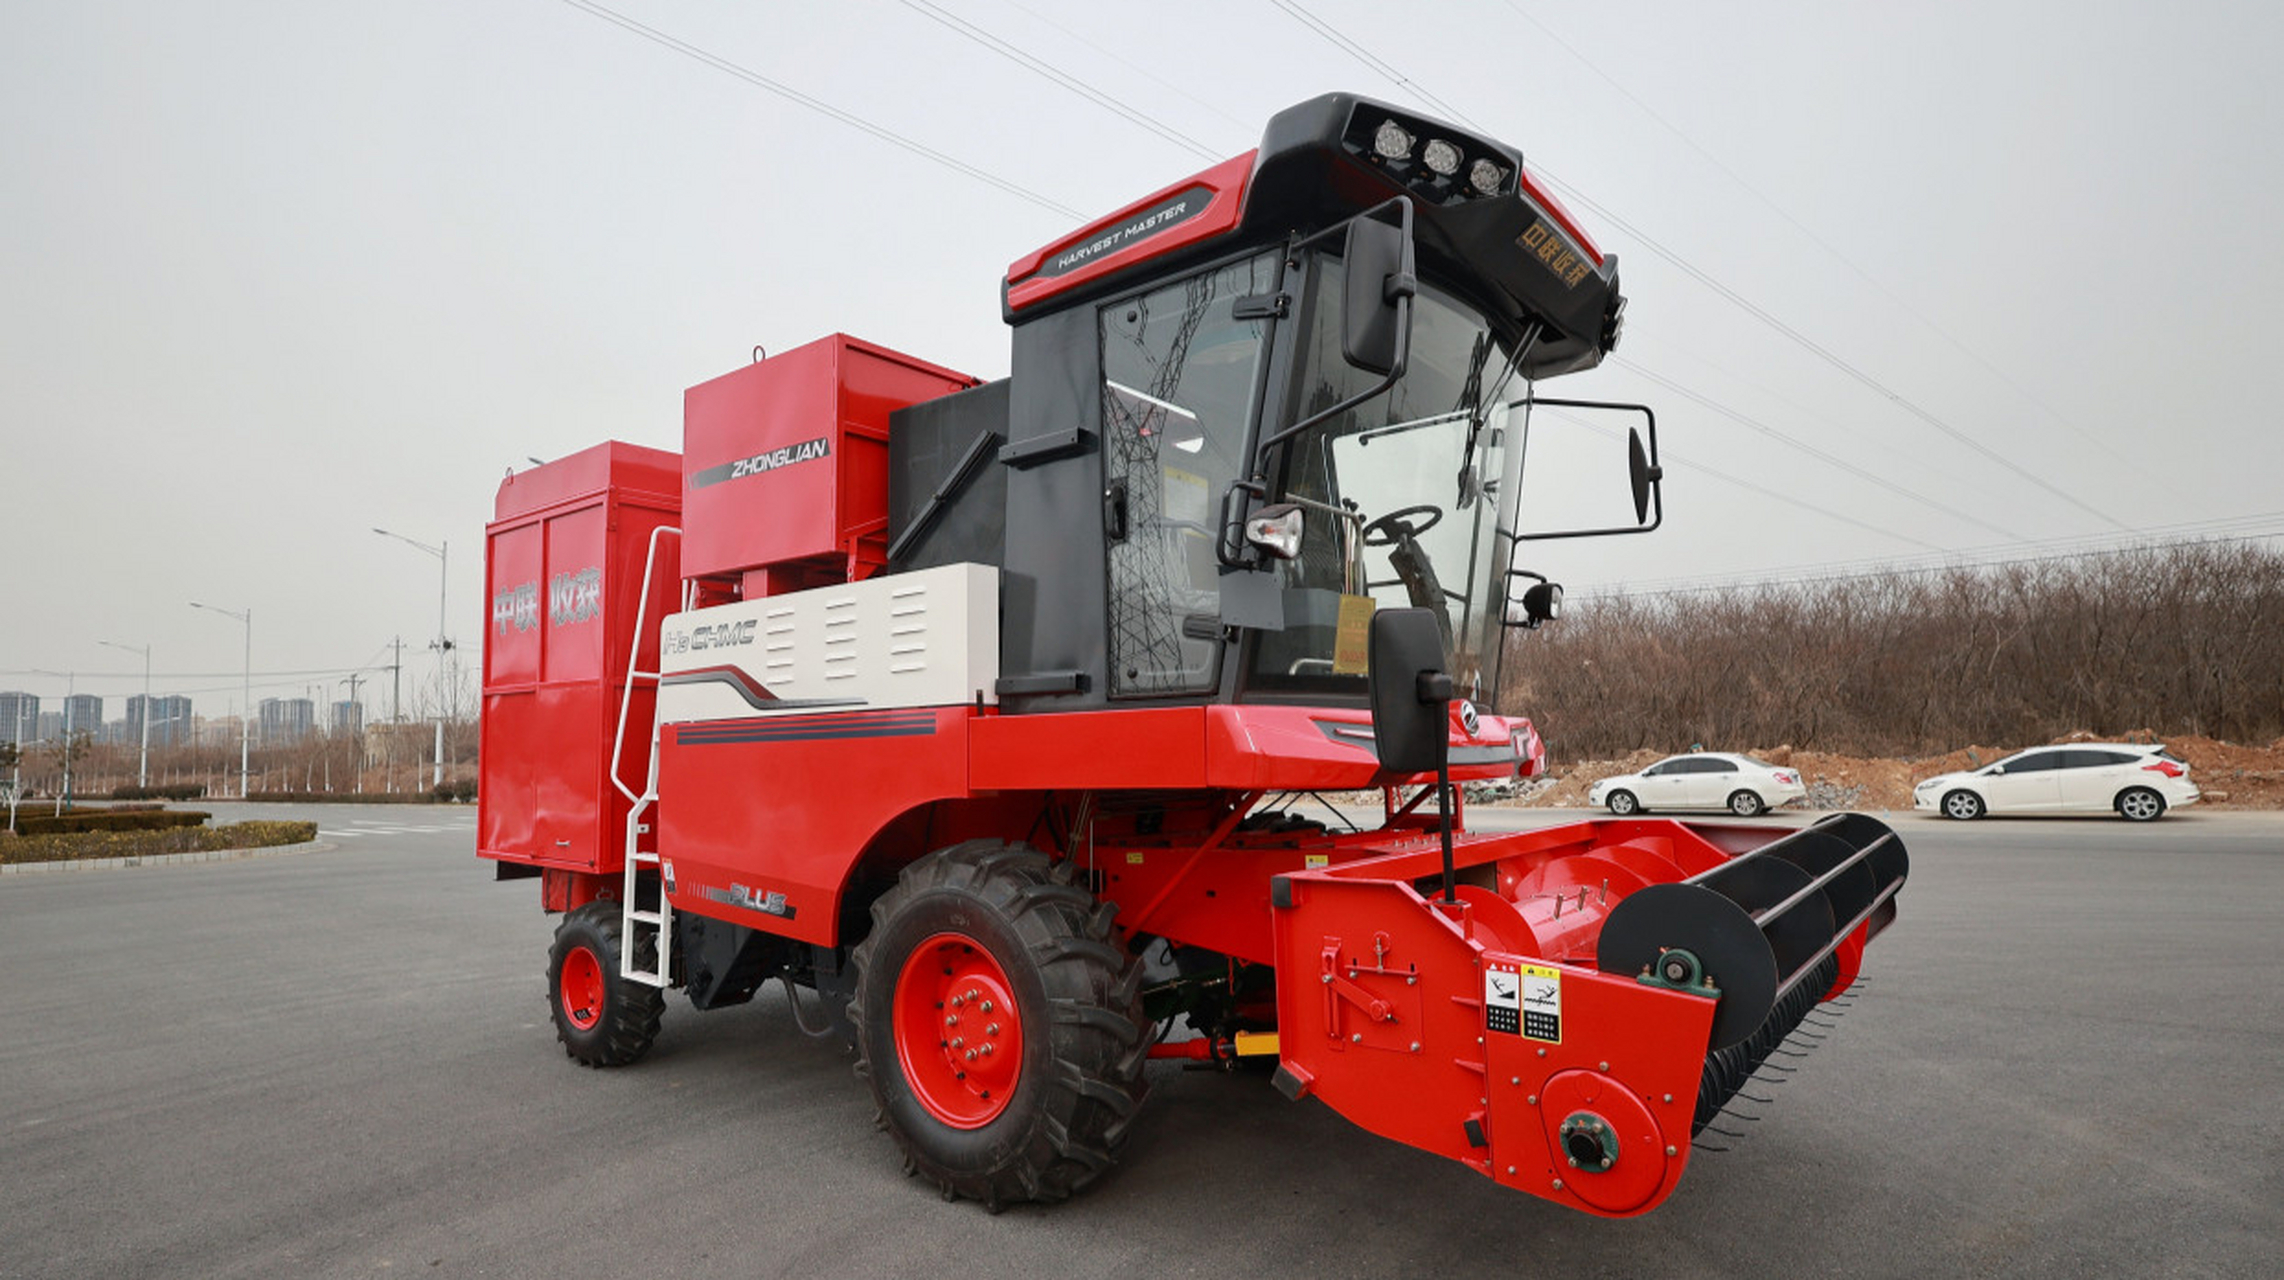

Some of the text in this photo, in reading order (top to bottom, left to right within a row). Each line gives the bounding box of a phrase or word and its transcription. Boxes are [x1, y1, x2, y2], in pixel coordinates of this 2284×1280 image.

[1058, 202, 1187, 269] HARVEST MASTER
[731, 438, 827, 479] ZHONGLIAN
[494, 565, 601, 635] 中联 收获
[691, 619, 758, 650] CHMC
[728, 882, 787, 915] PLUS
